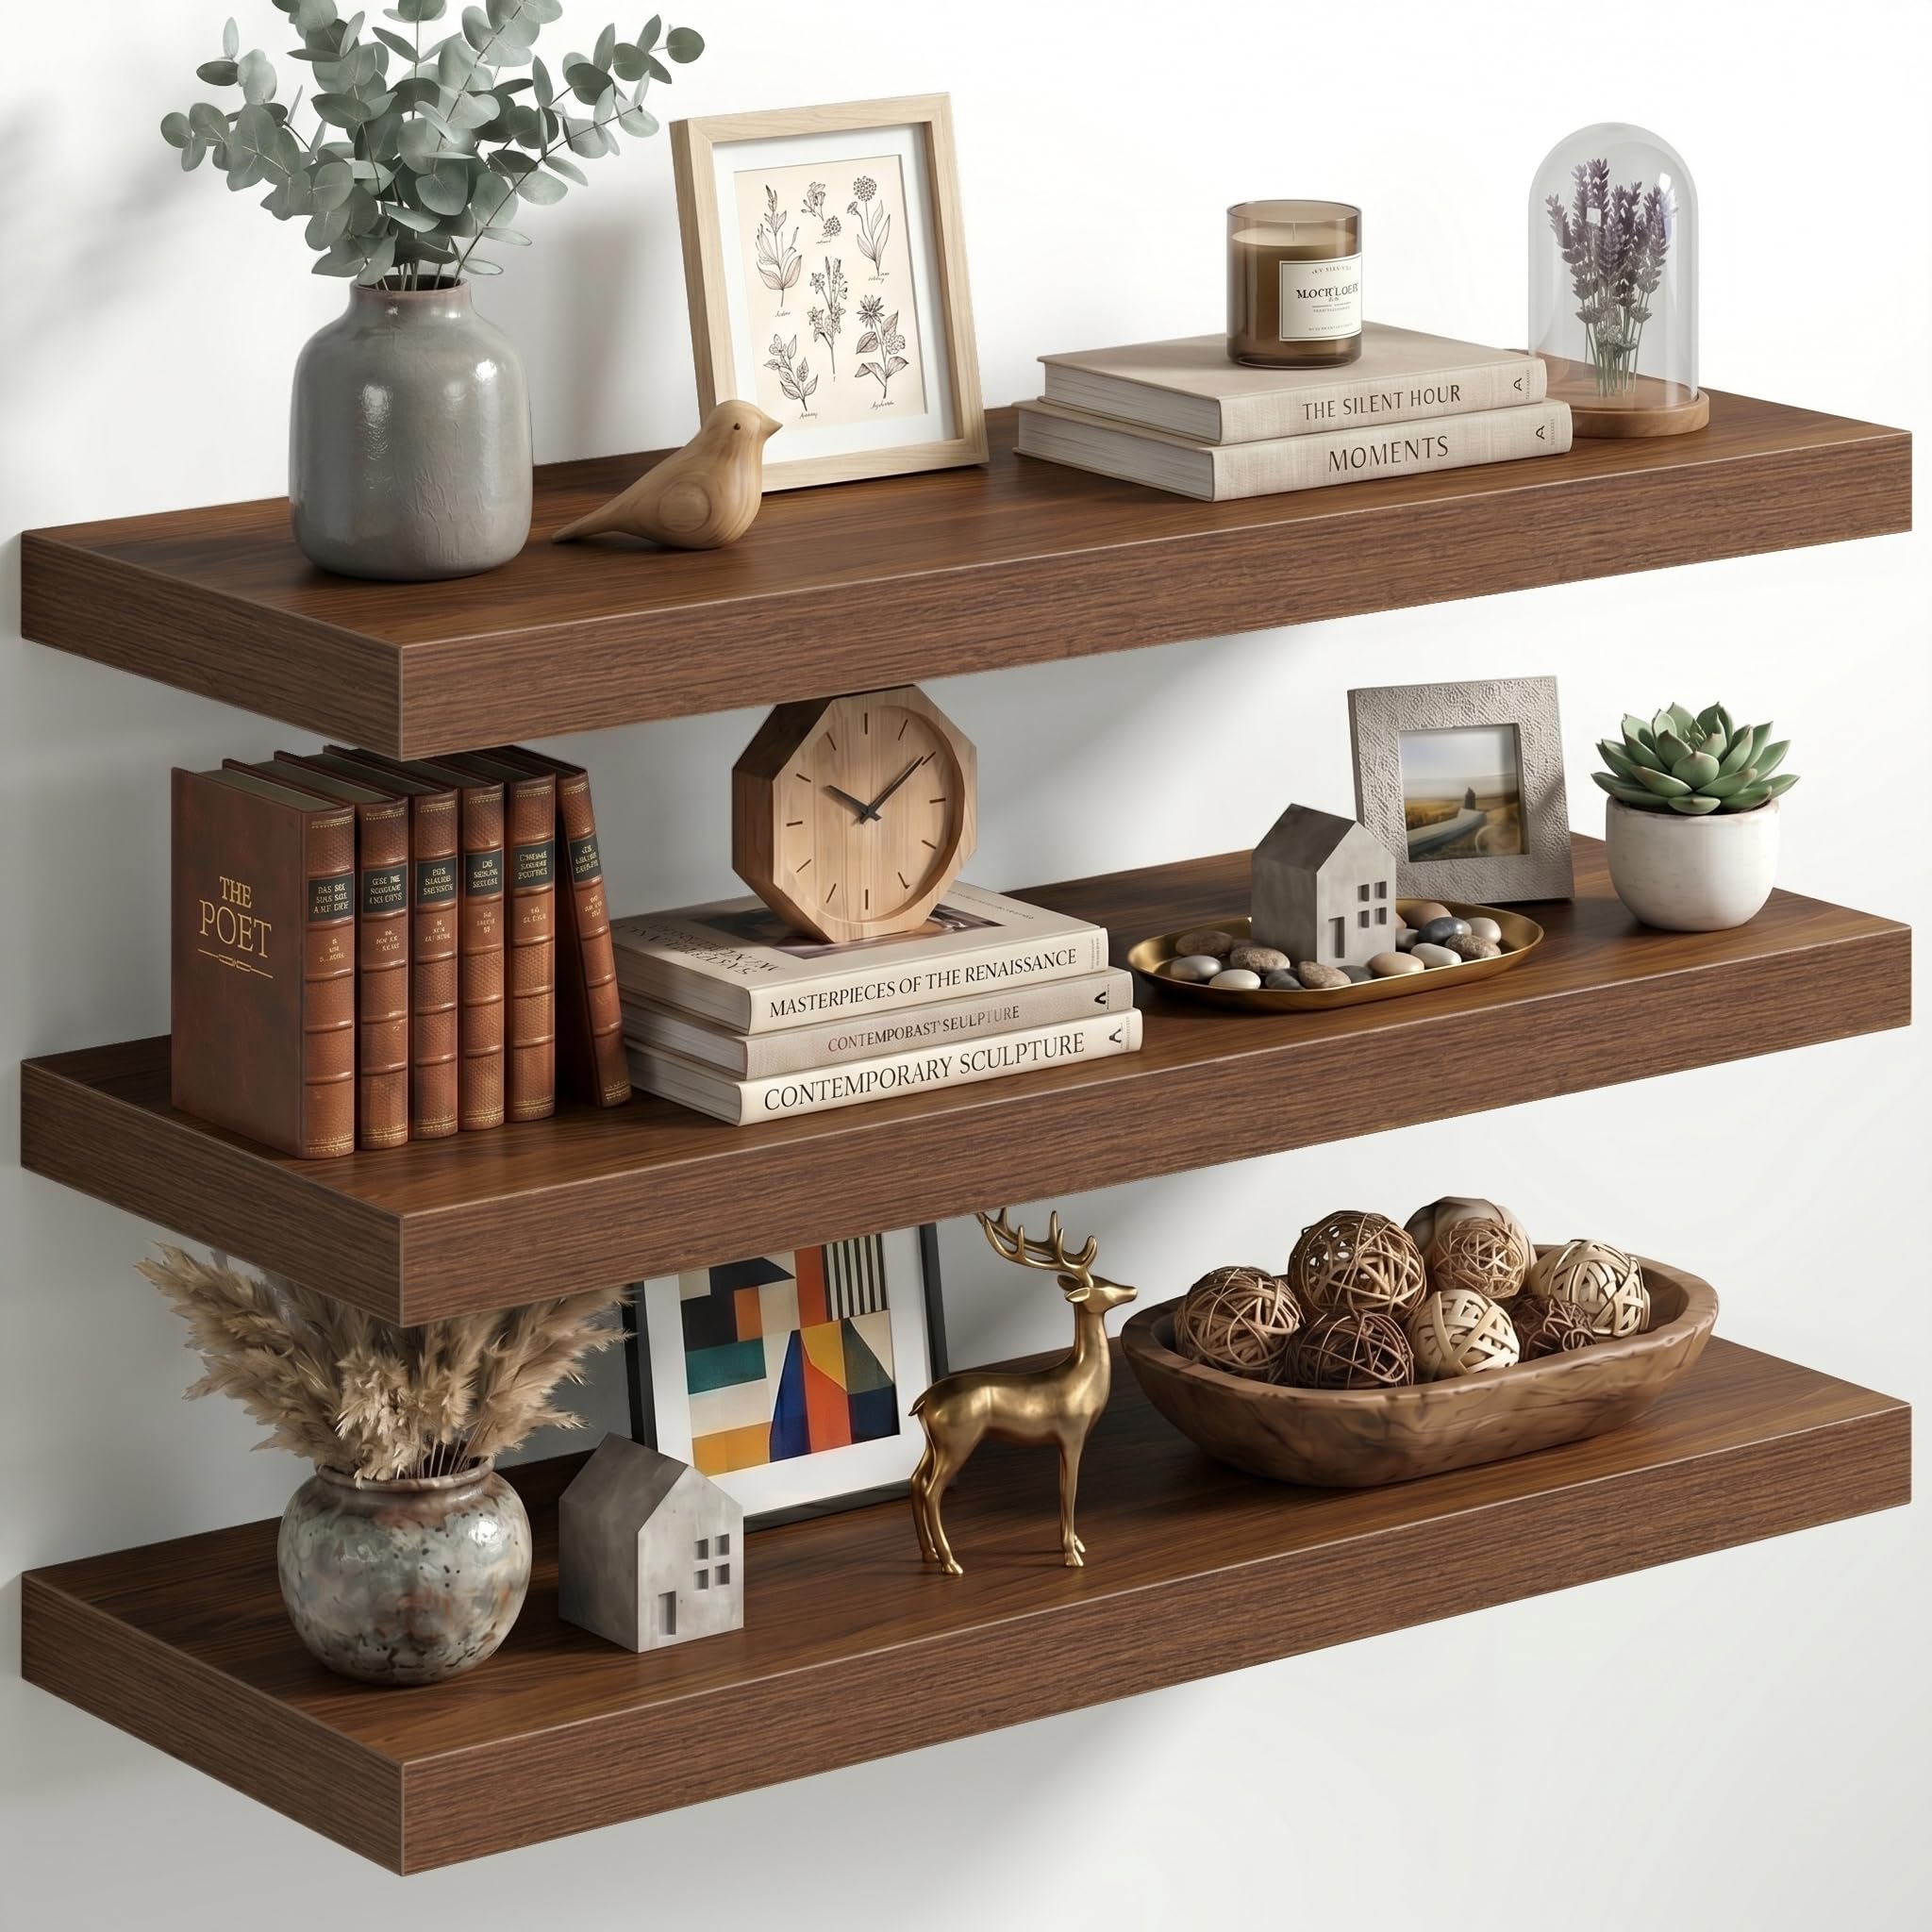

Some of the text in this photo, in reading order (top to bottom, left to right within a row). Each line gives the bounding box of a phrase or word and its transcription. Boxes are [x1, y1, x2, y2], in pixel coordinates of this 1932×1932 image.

[1302, 384, 1461, 421] THE SILENT HOUR
[1328, 435, 1449, 473] MOMENTS
[219, 875, 253, 909] THE
[198, 899, 273, 958] POET
[769, 980, 895, 1018] MASTERPIECES
[899, 975, 922, 994] OF
[925, 969, 961, 990] THE
[965, 948, 1077, 983] RENAISSANCE
[764, 1056, 953, 1111] CONTEMPORARY
[959, 1032, 1085, 1074] SCULPTURE
